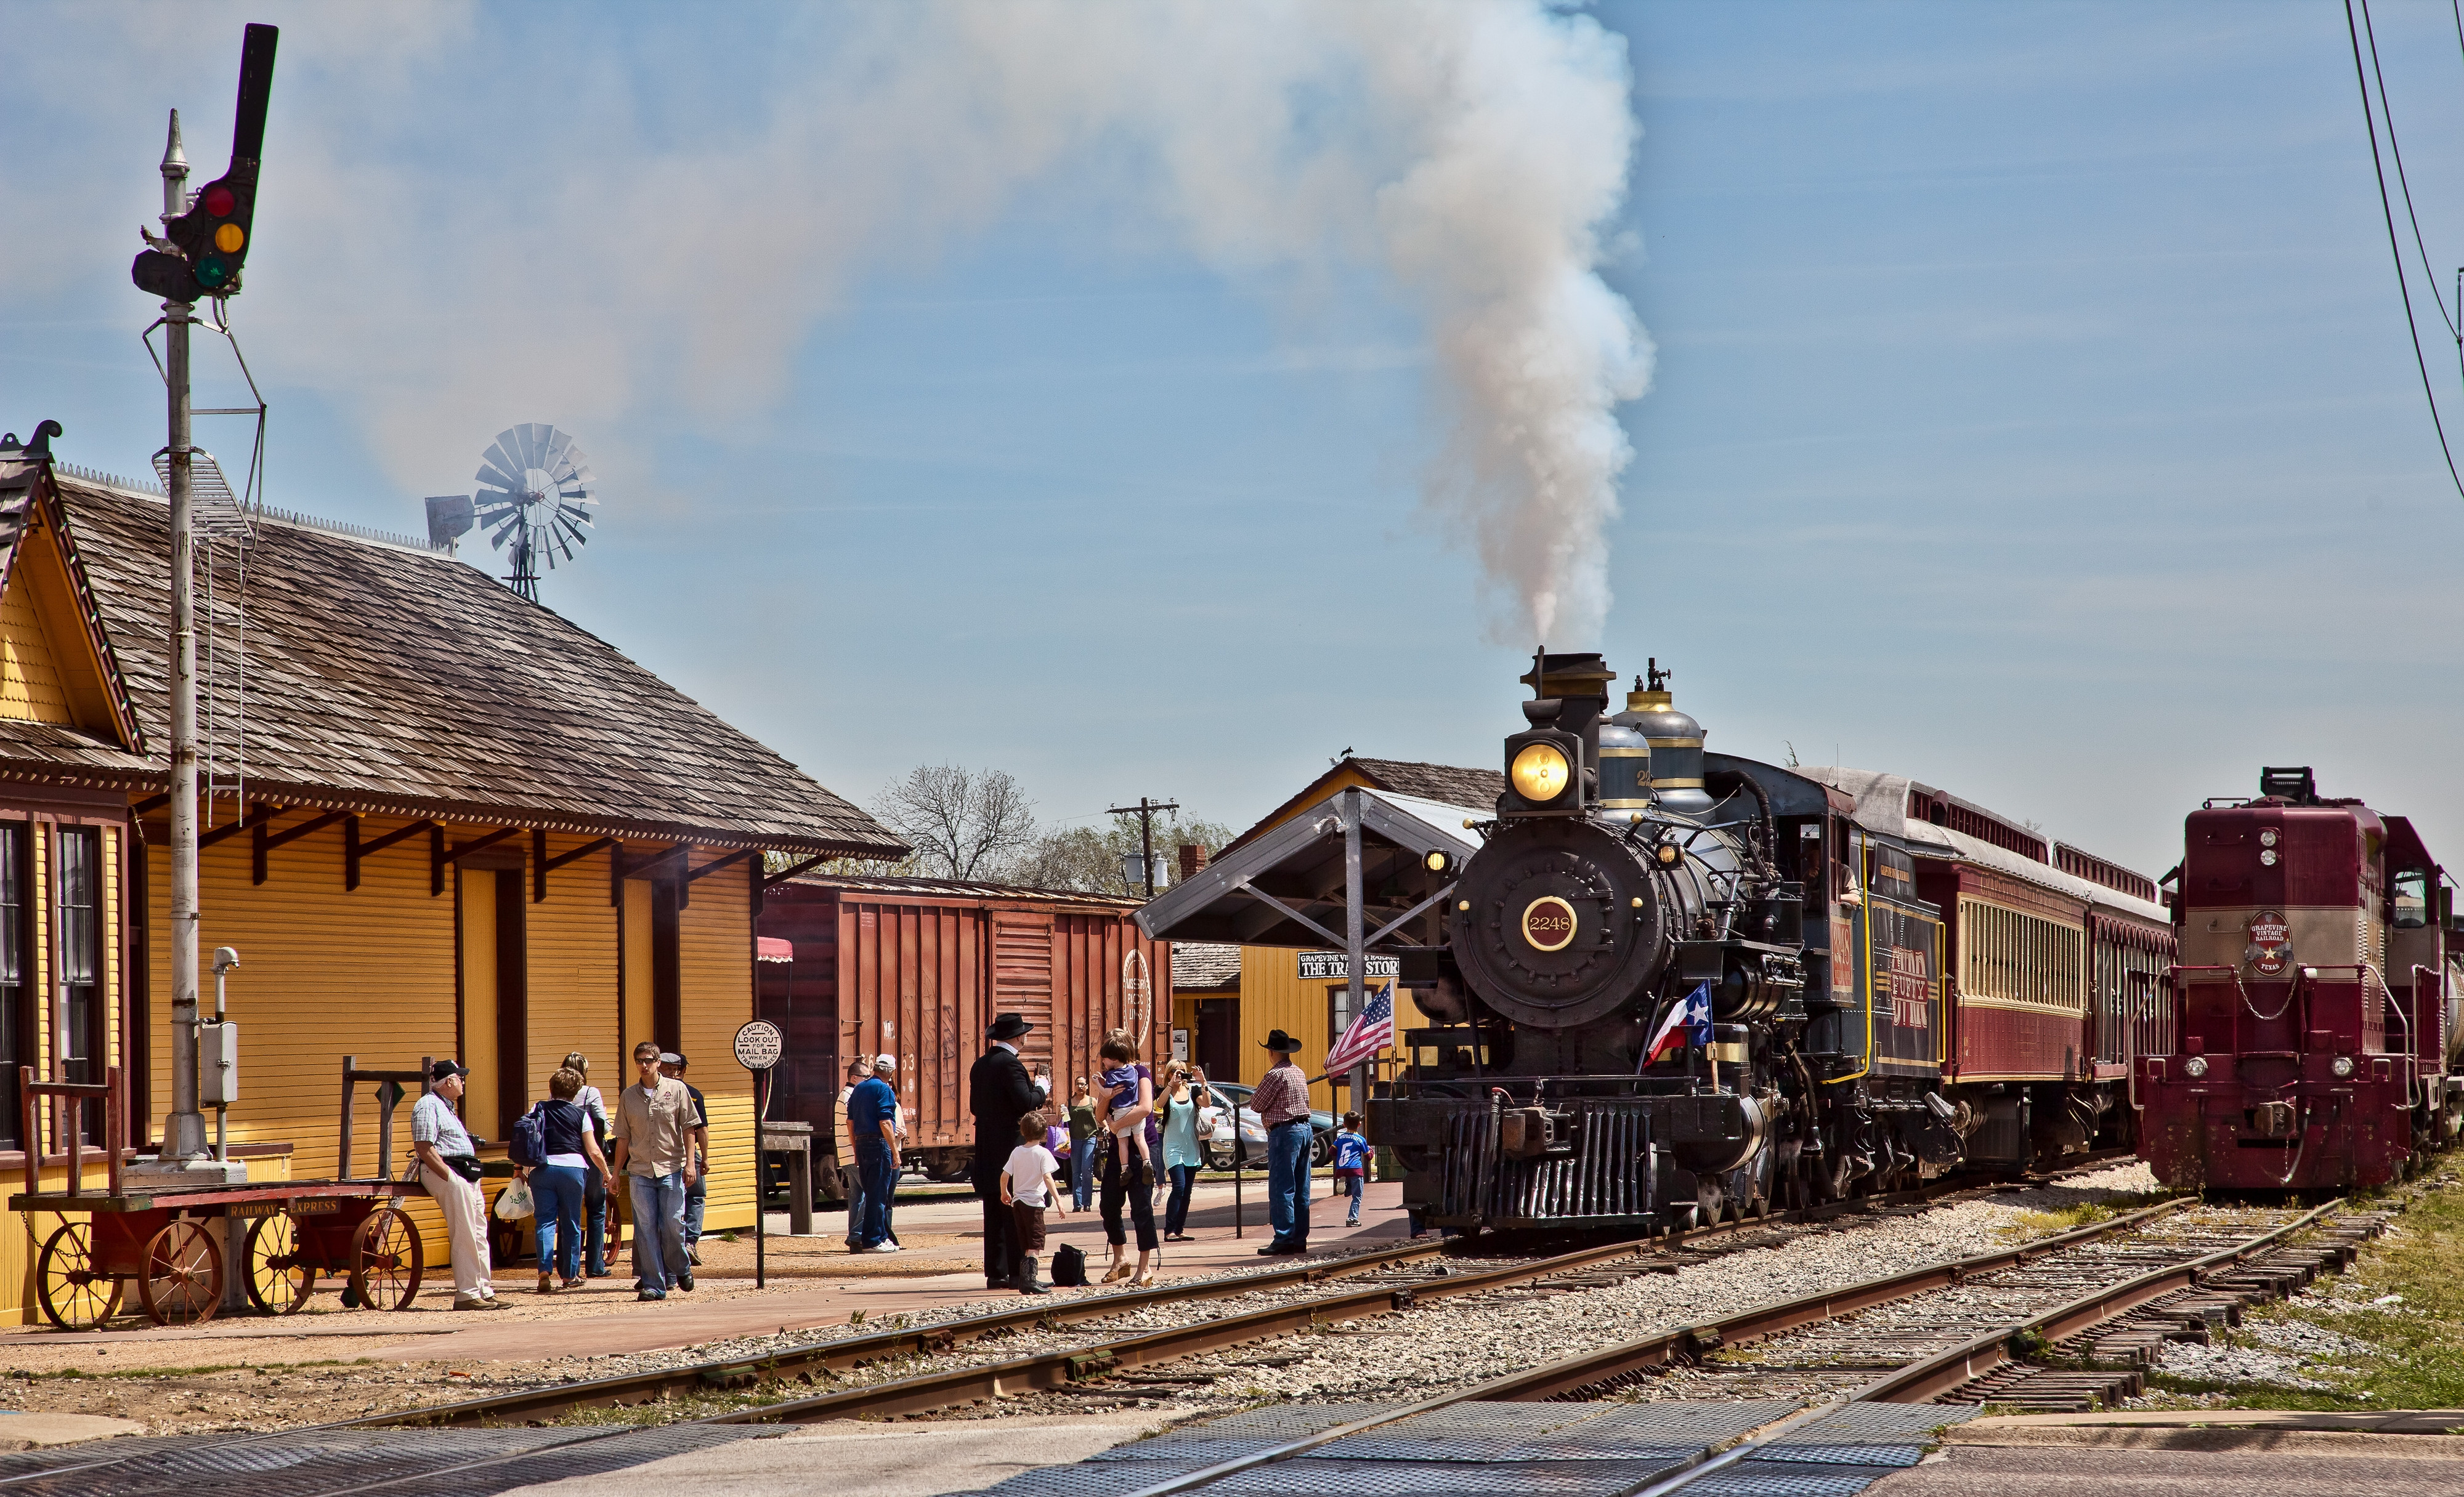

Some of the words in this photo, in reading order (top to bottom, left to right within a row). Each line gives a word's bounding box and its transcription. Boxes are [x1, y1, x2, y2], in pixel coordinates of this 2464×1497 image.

[1530, 917, 1570, 930] 2248
[1302, 962, 1326, 976] THE
[1366, 961, 1400, 974] STOR
[742, 1024, 775, 1036] CAUTION
[741, 1055, 756, 1068] TRAIN
[757, 1054, 777, 1068] PASSES
[1339, 1142, 1351, 1167] 5
[231, 1204, 277, 1217] RAILWAY
